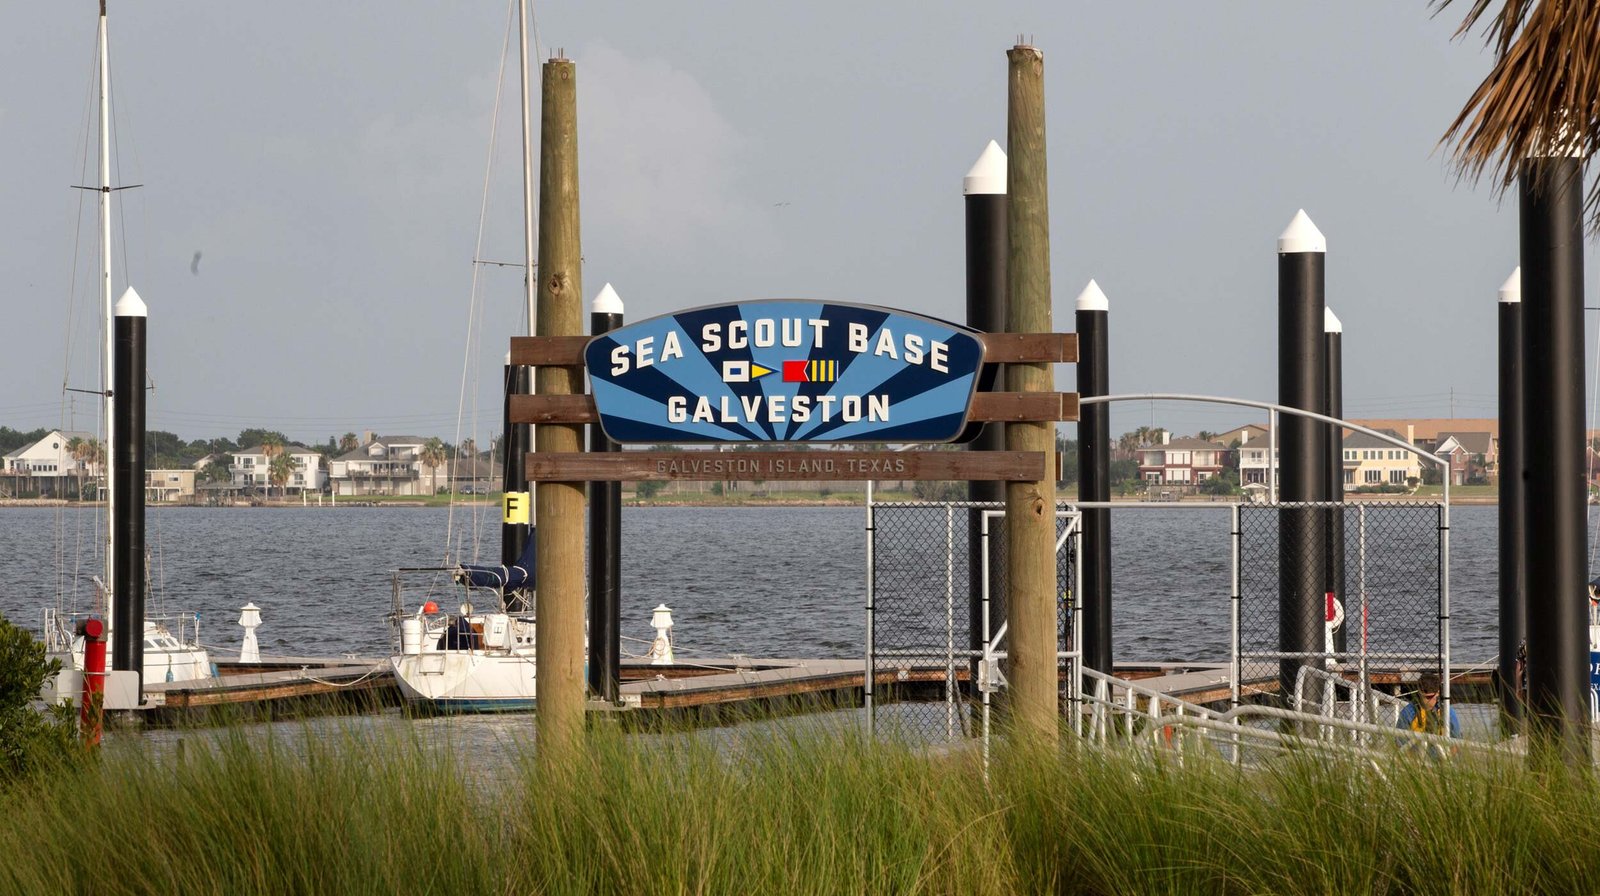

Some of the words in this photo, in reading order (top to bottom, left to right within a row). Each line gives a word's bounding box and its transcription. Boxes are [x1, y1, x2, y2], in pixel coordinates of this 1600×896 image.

[611, 330, 684, 377] SEA
[702, 318, 830, 353] SCOUT
[848, 322, 949, 374] BASE
[667, 394, 890, 423] GALVESTON
[656, 459, 760, 474] GALVESTON
[769, 458, 841, 475] ISLAND,
[849, 458, 906, 473] TEXAS
[506, 497, 519, 518] F
